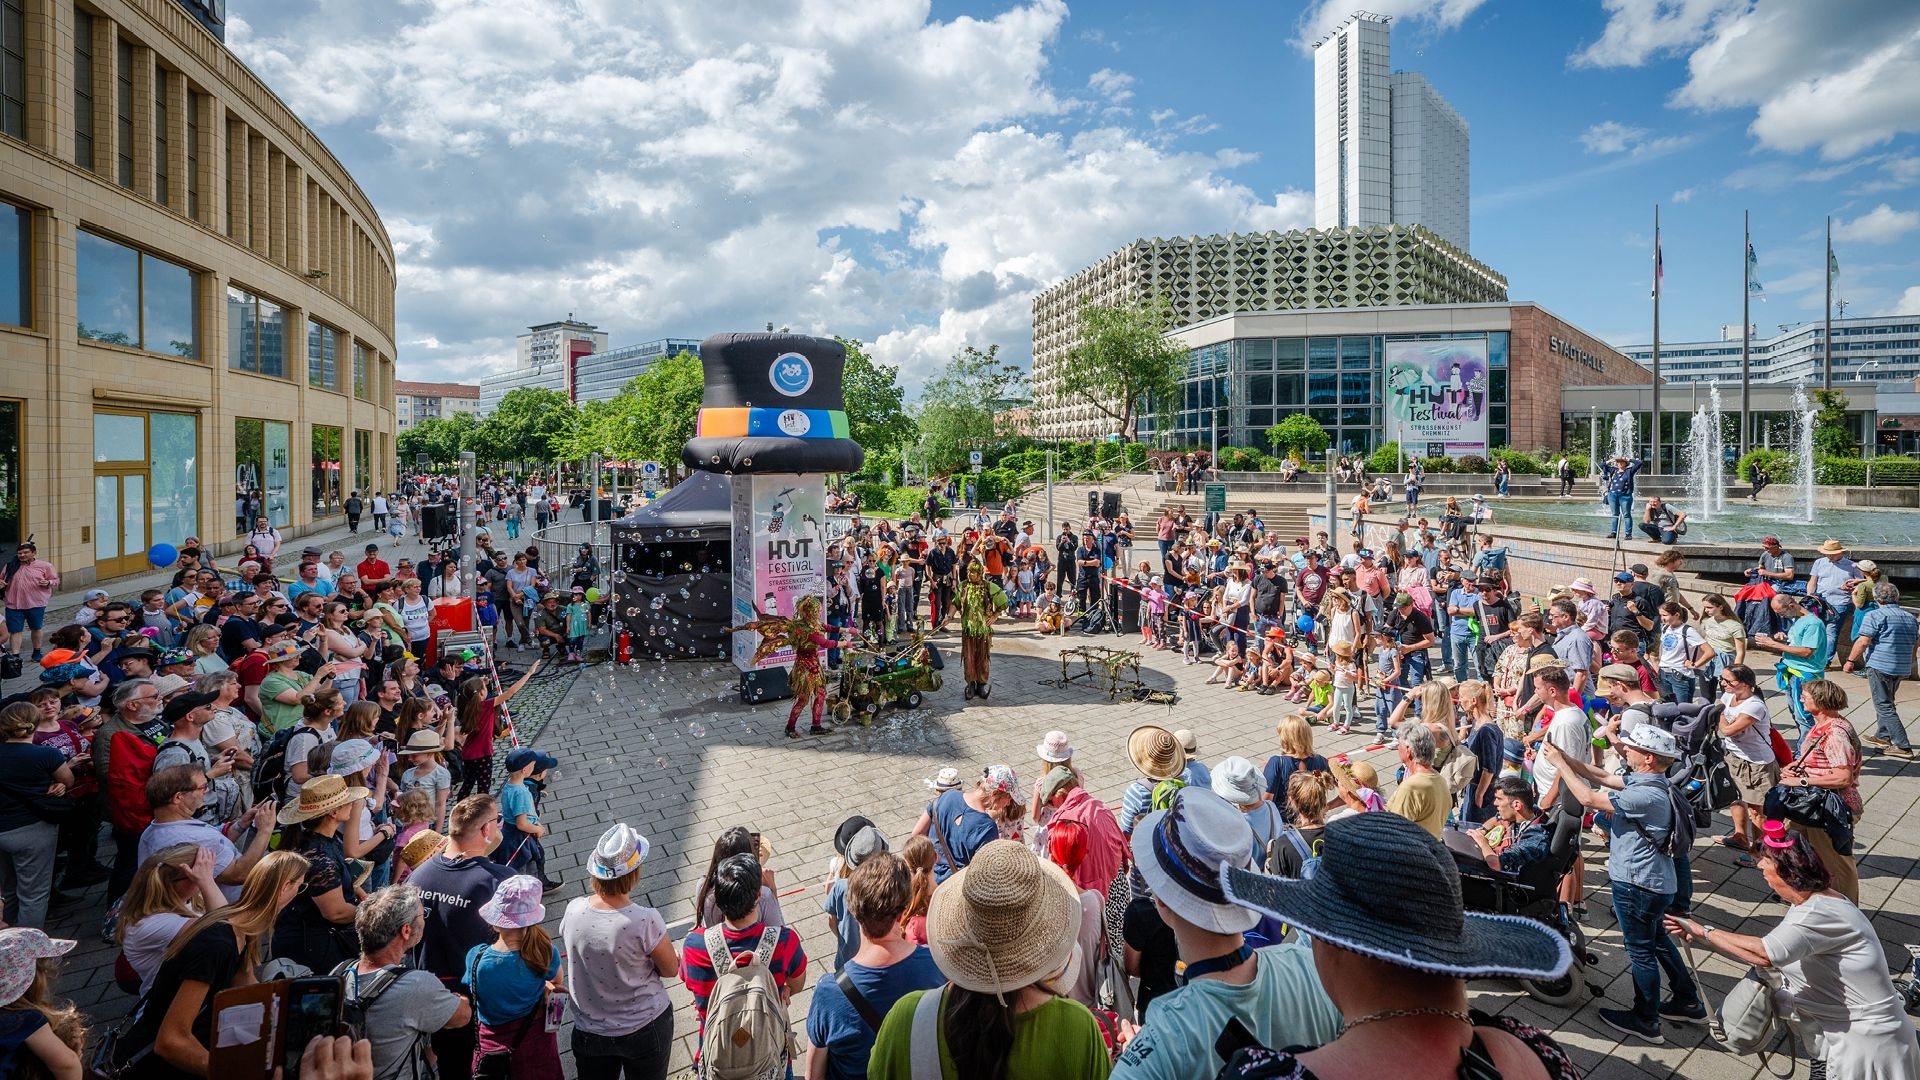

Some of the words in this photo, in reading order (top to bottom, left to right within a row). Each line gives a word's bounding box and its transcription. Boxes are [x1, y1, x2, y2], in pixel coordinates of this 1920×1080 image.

[1549, 336, 1605, 373] STADTHALLE
[1409, 403, 1462, 421] Festival
[768, 538, 814, 560] HUT
[768, 576, 814, 587] STRASSENKUNST
[777, 583, 806, 593] CHEMNITZ
[418, 890, 471, 908] uerwehr
